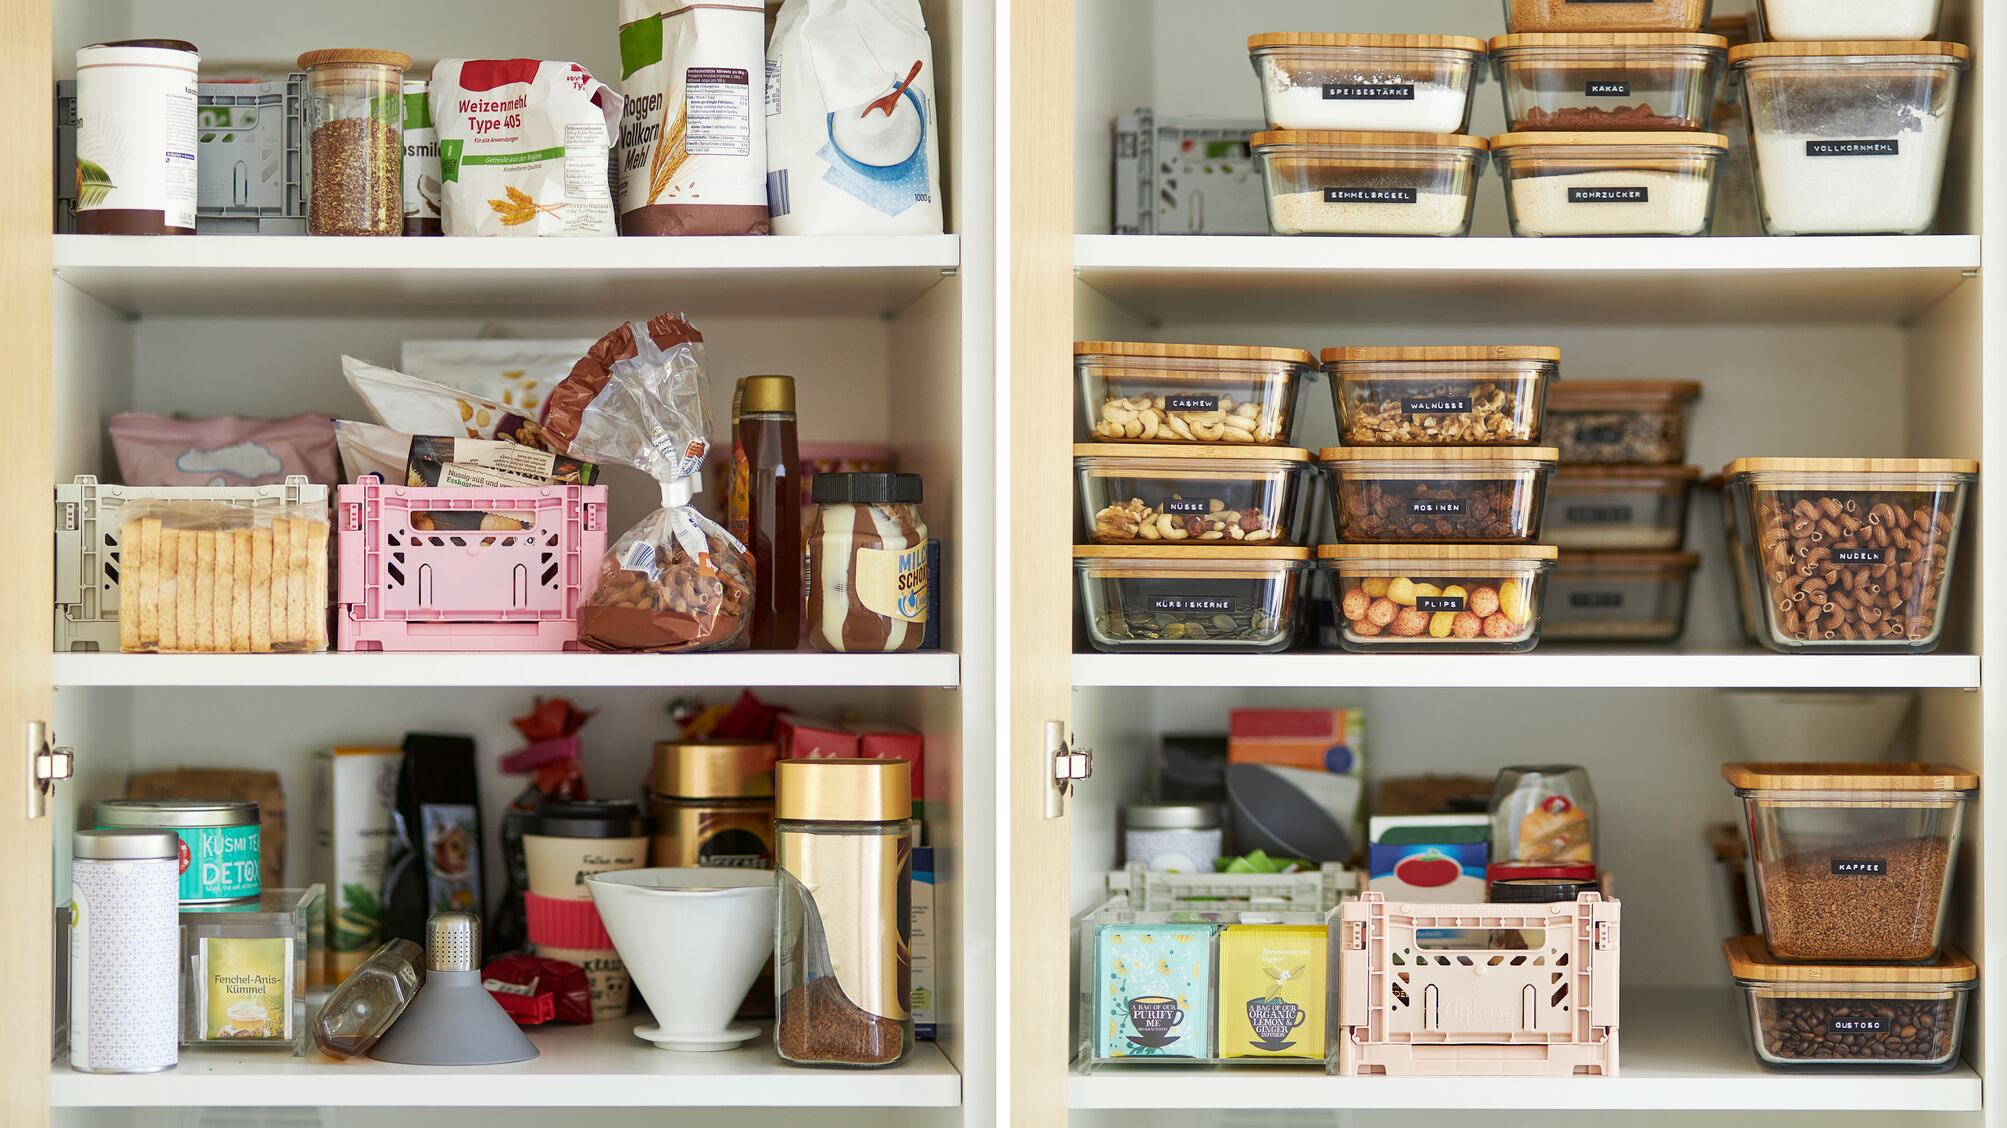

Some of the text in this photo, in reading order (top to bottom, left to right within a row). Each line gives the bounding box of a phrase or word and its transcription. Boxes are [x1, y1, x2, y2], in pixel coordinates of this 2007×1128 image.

[1329, 87, 1409, 96] SPEISESTÄRKE
[458, 94, 527, 113] Weizenmehl
[623, 92, 663, 121] Roggen
[468, 114, 521, 134] Type 405
[620, 122, 660, 149] Vollkorn
[1813, 144, 1893, 152] VOLLKORNMEHL
[485, 156, 509, 164] Getreide
[624, 144, 650, 172] Mehl
[1330, 191, 1410, 199] SEMMELBRÖSEL
[1575, 191, 1641, 199] ROHRZUCKER
[1410, 401, 1464, 409] WALNÜSSE
[447, 469, 499, 488] Nussig-süß und
[1170, 502, 1203, 510] NÜSSE
[899, 546, 928, 574] MILC
[1839, 552, 1880, 560] NUDELN
[1155, 599, 1229, 608] KÜRBISKERNE
[1424, 600, 1457, 608] FLIPS
[203, 832, 259, 858] KUSMI TE
[202, 859, 259, 886] DETOX
[214, 974, 281, 984] Fenchel-Anis-
[226, 984, 266, 994] Kümmel
[1133, 1010, 1174, 1019] PURIFY
[1248, 1010, 1297, 1019] ORGANIC
[1146, 1019, 1162, 1027] ME
[1253, 1018, 1284, 1026] LEMON
[1835, 1021, 1880, 1029] GUSTOSO
[1255, 1025, 1289, 1033] GINGER
